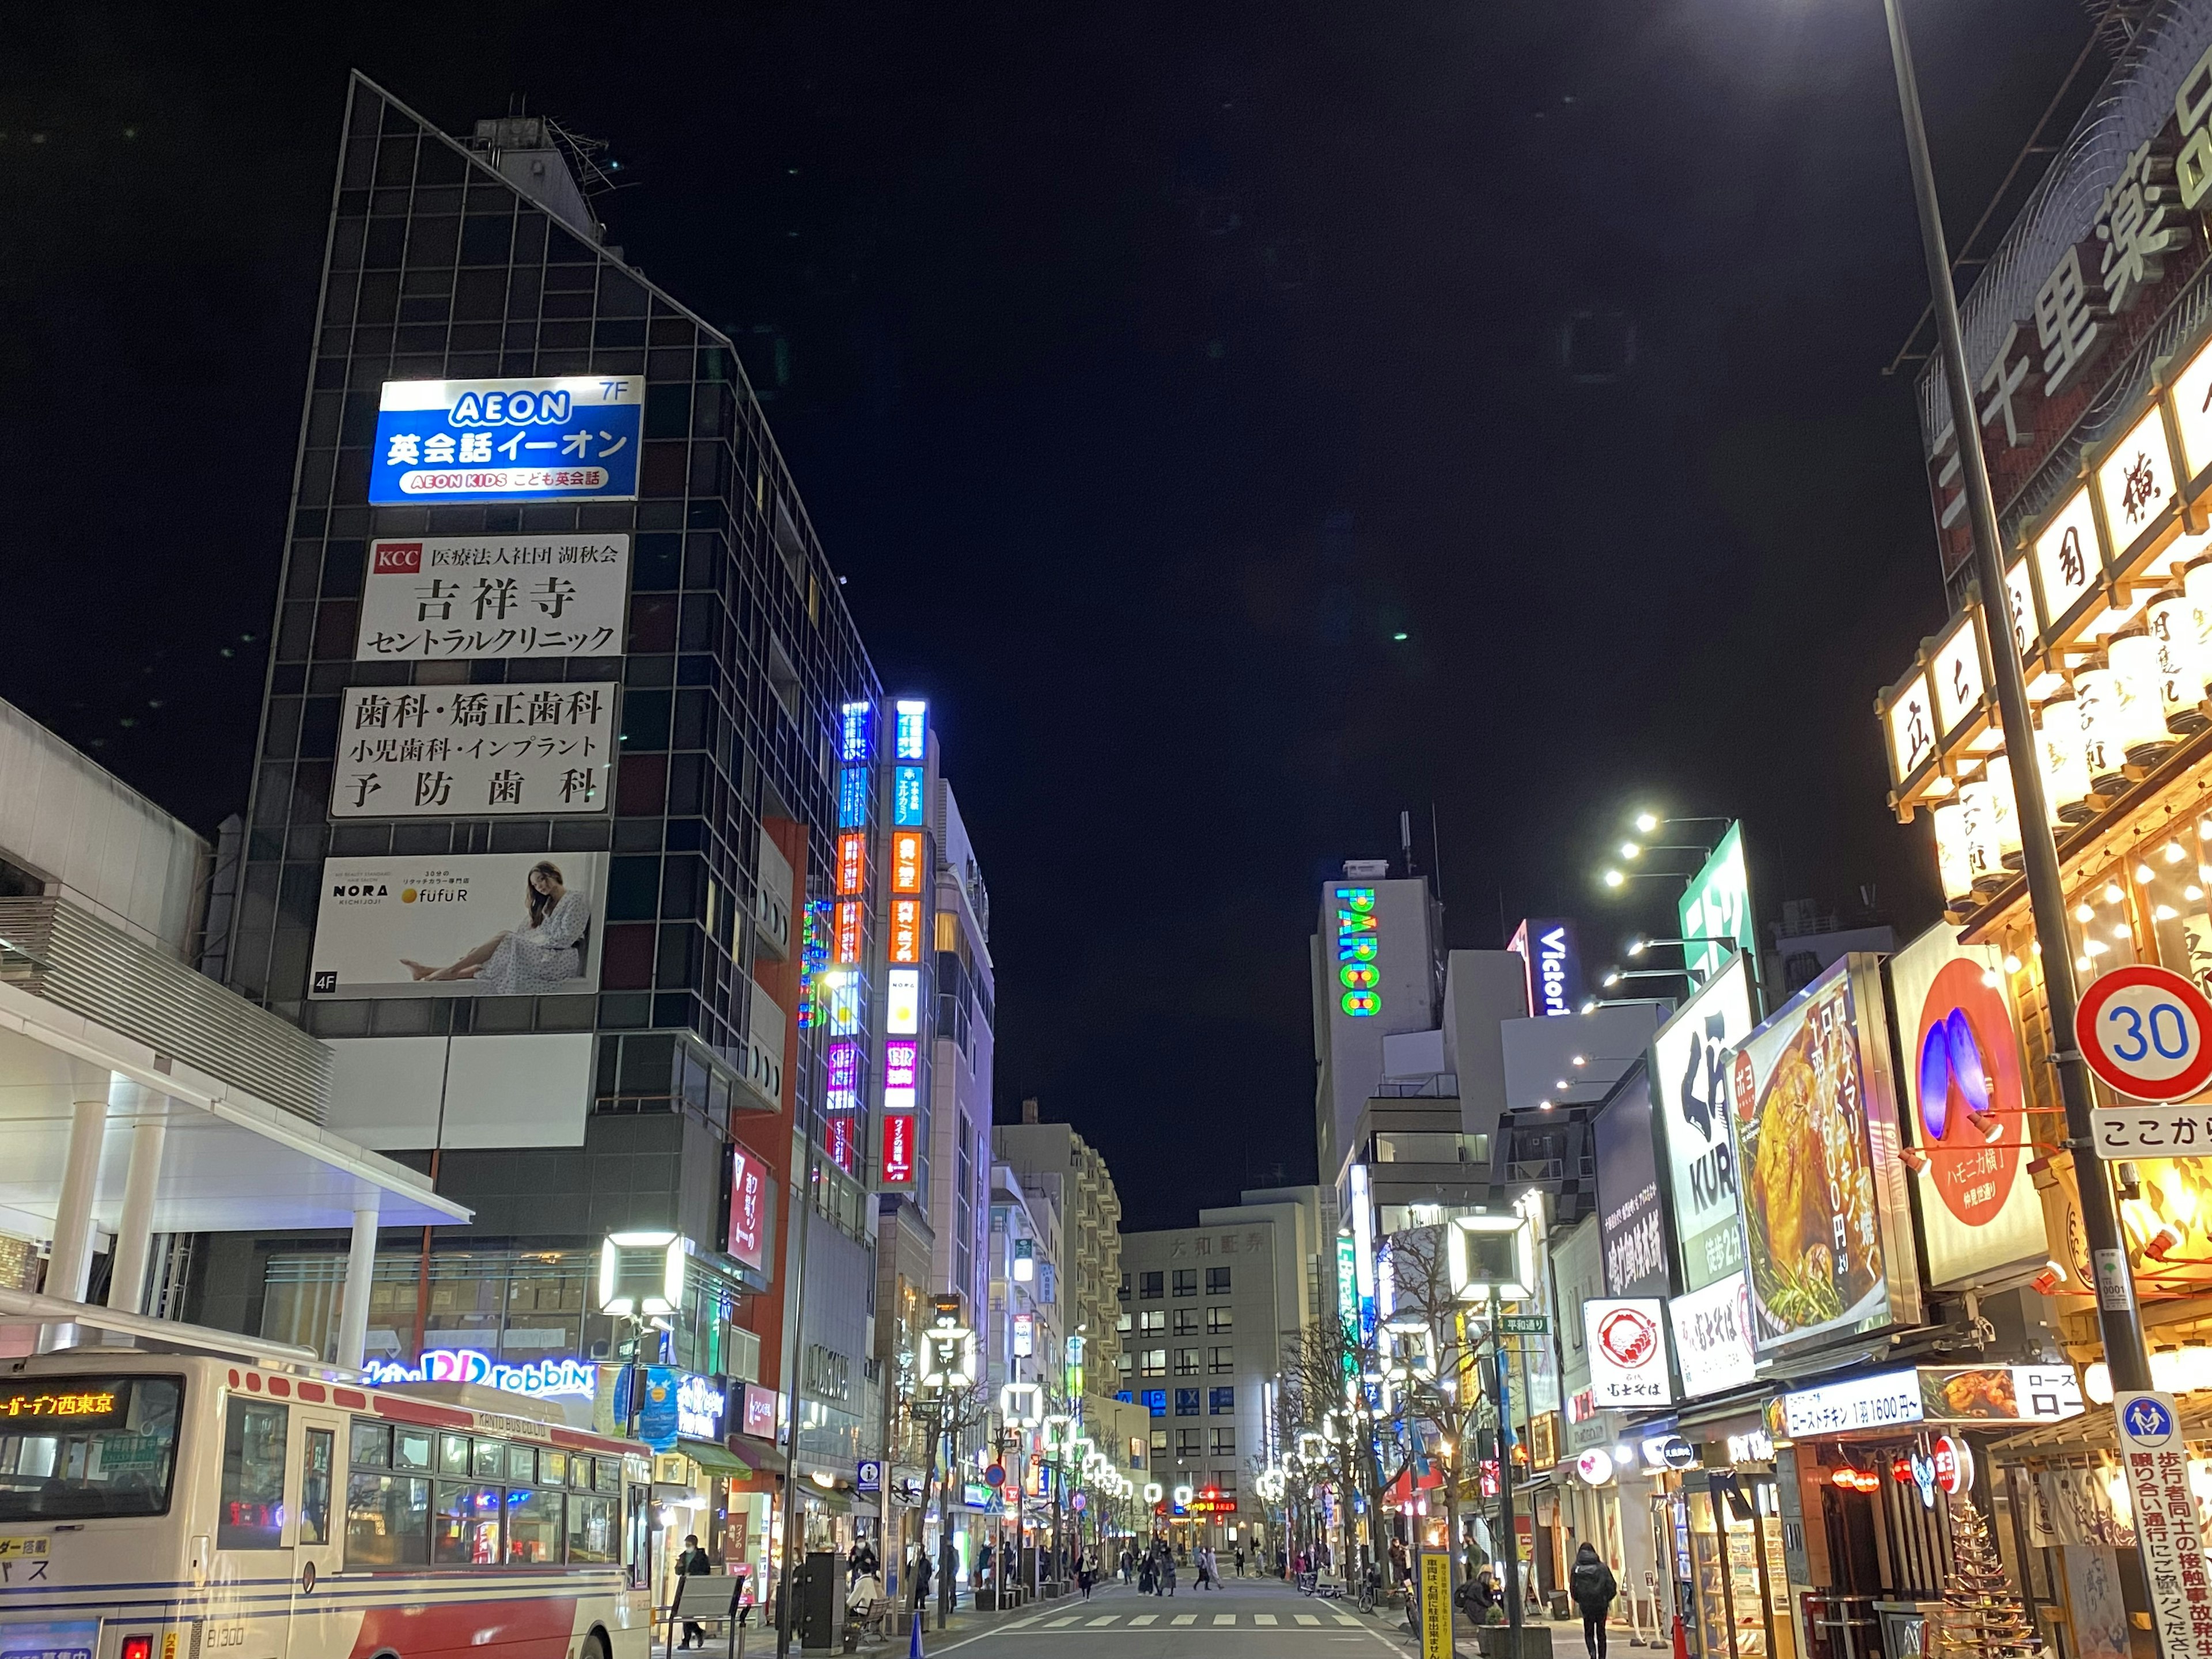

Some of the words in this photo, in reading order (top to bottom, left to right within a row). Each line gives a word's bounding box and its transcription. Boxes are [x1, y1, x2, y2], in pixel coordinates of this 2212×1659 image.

[599, 381, 628, 401] 7F
[452, 392, 570, 424] AEON
[387, 429, 628, 466] 英会話イーオン
[411, 474, 463, 489] AEON
[465, 473, 507, 488] KIDS
[514, 470, 600, 487] こども英会話
[378, 550, 419, 567] KCC
[431, 547, 551, 566] 医療法人社団
[558, 544, 619, 565] 湖秋会
[414, 577, 578, 621] 吉祥寺
[366, 626, 615, 654] セントラルクリニック
[355, 690, 603, 729] 歯科・矯正歯科
[348, 735, 596, 763] 小児歯科・インプラント
[345, 767, 596, 808] 予防歯科
[333, 884, 388, 897] NORA
[1336, 888, 1382, 1017] PARCO
[316, 975, 335, 989] 4F
[2108, 1003, 2190, 1062] 30
[1946, 1143, 2006, 1187] ハモニカ横丁
[1963, 1183, 1997, 1210] 仲見世通り
[1171, 1232, 1265, 1259] 大和証券
[2104, 1285, 2125, 1295] 0001
[1507, 1319, 1544, 1331] 平和通り
[479, 1412, 504, 1429] KANTO
[506, 1418, 520, 1433] BUS
[1792, 1406, 1847, 1432] ローストチキン
[207, 1627, 244, 1648] B1300
